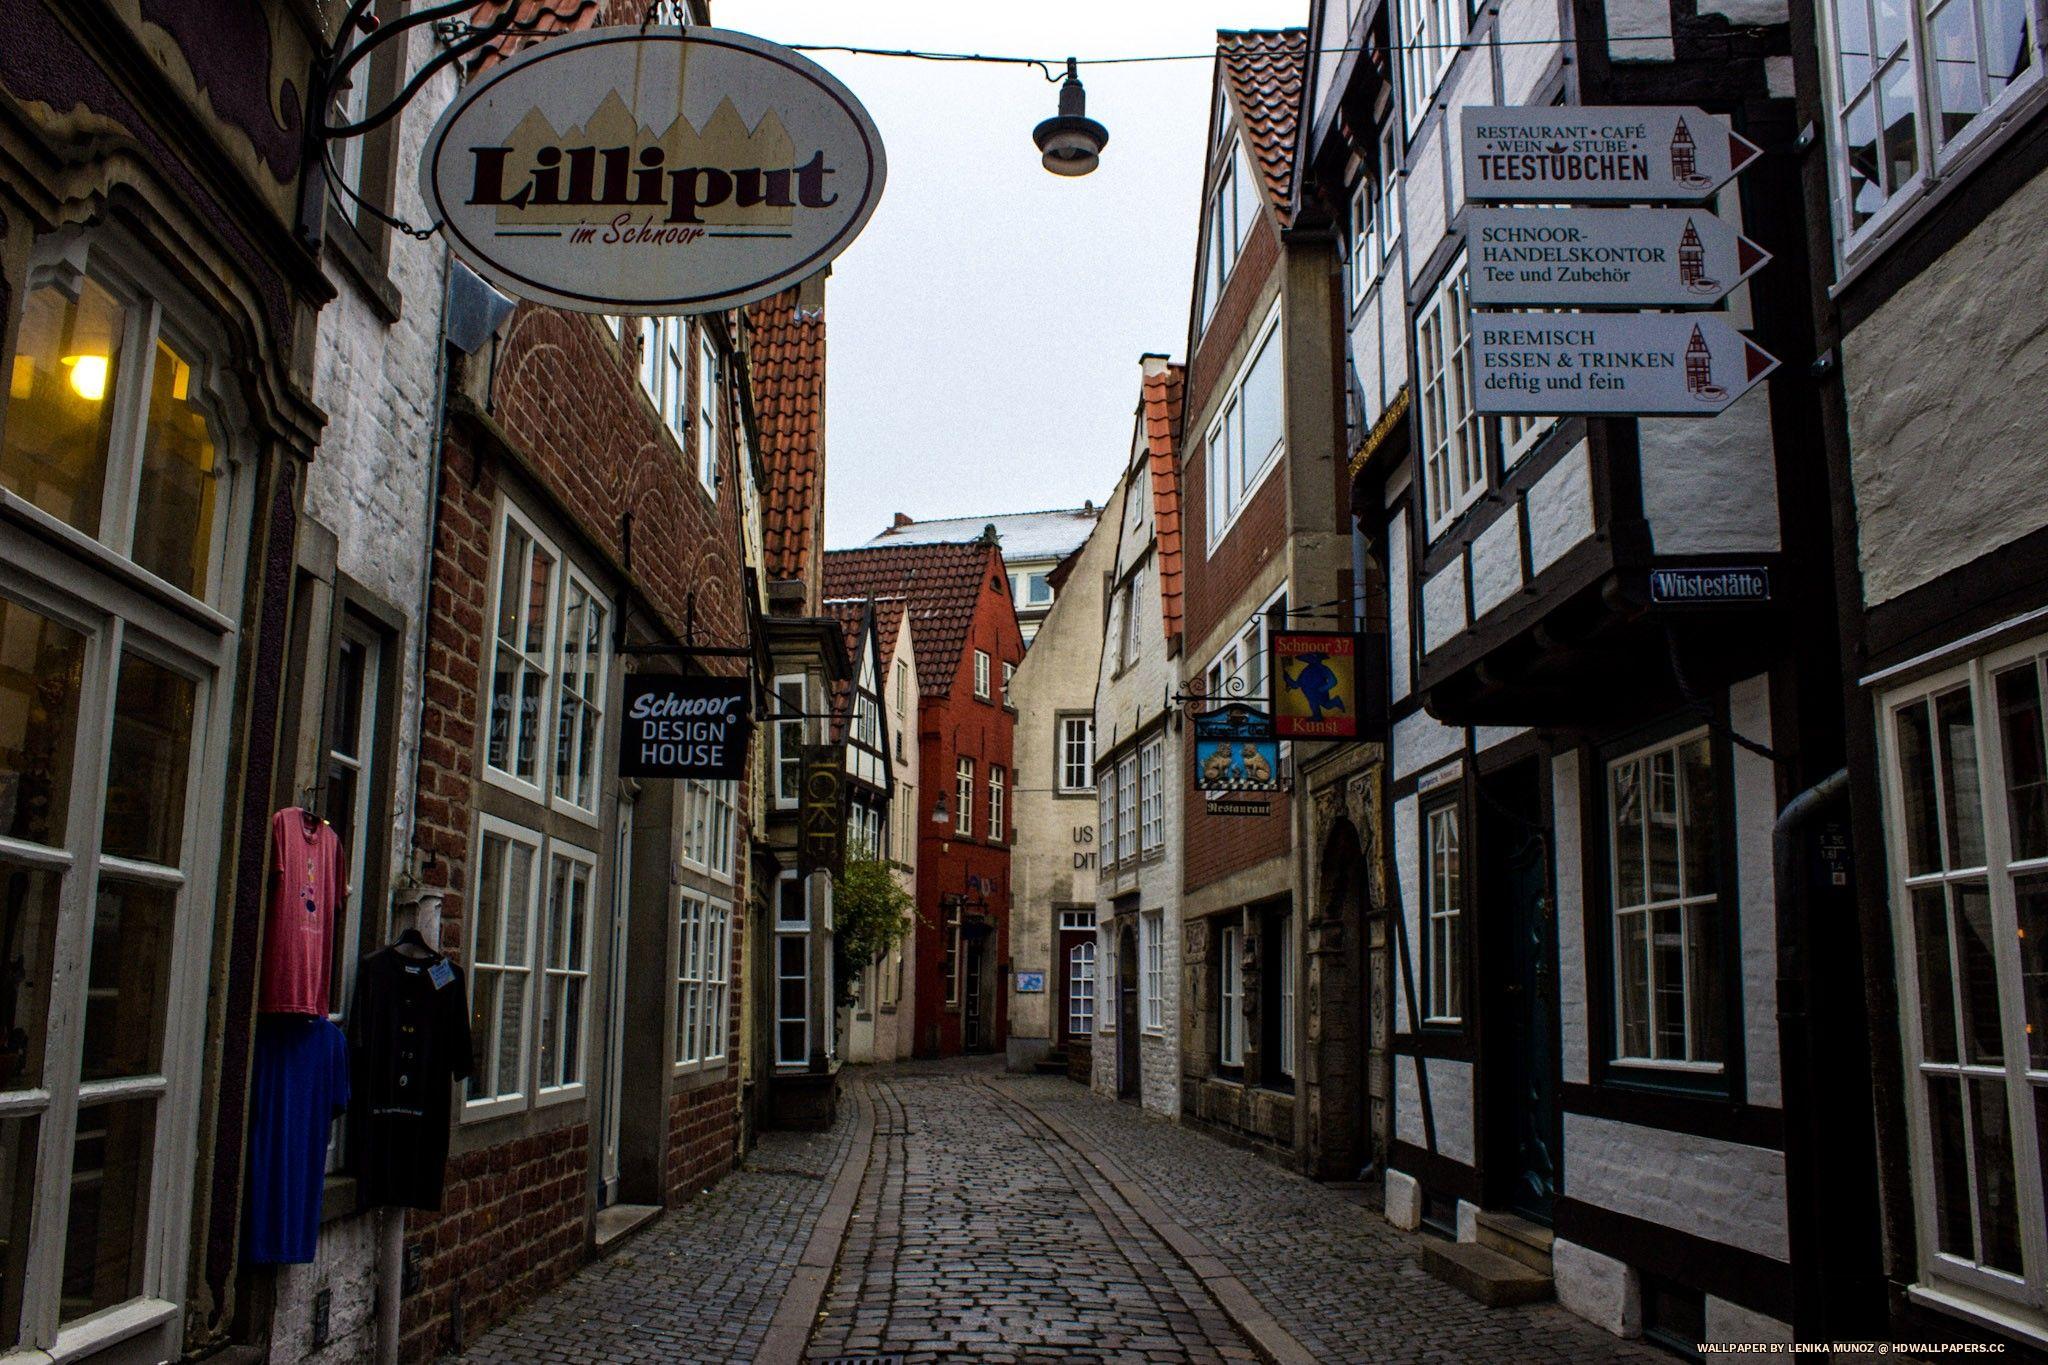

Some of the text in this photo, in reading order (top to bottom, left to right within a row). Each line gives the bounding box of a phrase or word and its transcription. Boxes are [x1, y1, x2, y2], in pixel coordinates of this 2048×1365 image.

[1477, 123, 1647, 139] RESTAURANT CAFÉ
[1498, 140, 1628, 153] WEIN STUBE
[464, 145, 839, 225] Lilliput
[568, 212, 706, 245] im Schnoor
[1482, 227, 1588, 243] SCHNOOR-
[1483, 247, 1667, 263] HANDELSKONTOR
[1483, 266, 1631, 283] Tee und Zubehör
[1483, 330, 1595, 346] BREMISCH
[1485, 352, 1675, 368] ESSEN & TRINKEN
[1485, 372, 1626, 394] deftig und fein
[1657, 572, 1763, 597] Wüstestätte
[1280, 639, 1351, 653] Schnoor 37
[629, 692, 741, 719] Schnoor
[642, 720, 725, 742] DESIGN
[1293, 718, 1338, 735] Kunst
[641, 743, 724, 767] HOUSE
[1207, 802, 1269, 814] Restaurant
[1073, 826, 1094, 843] US
[1073, 852, 1097, 869] DIT
